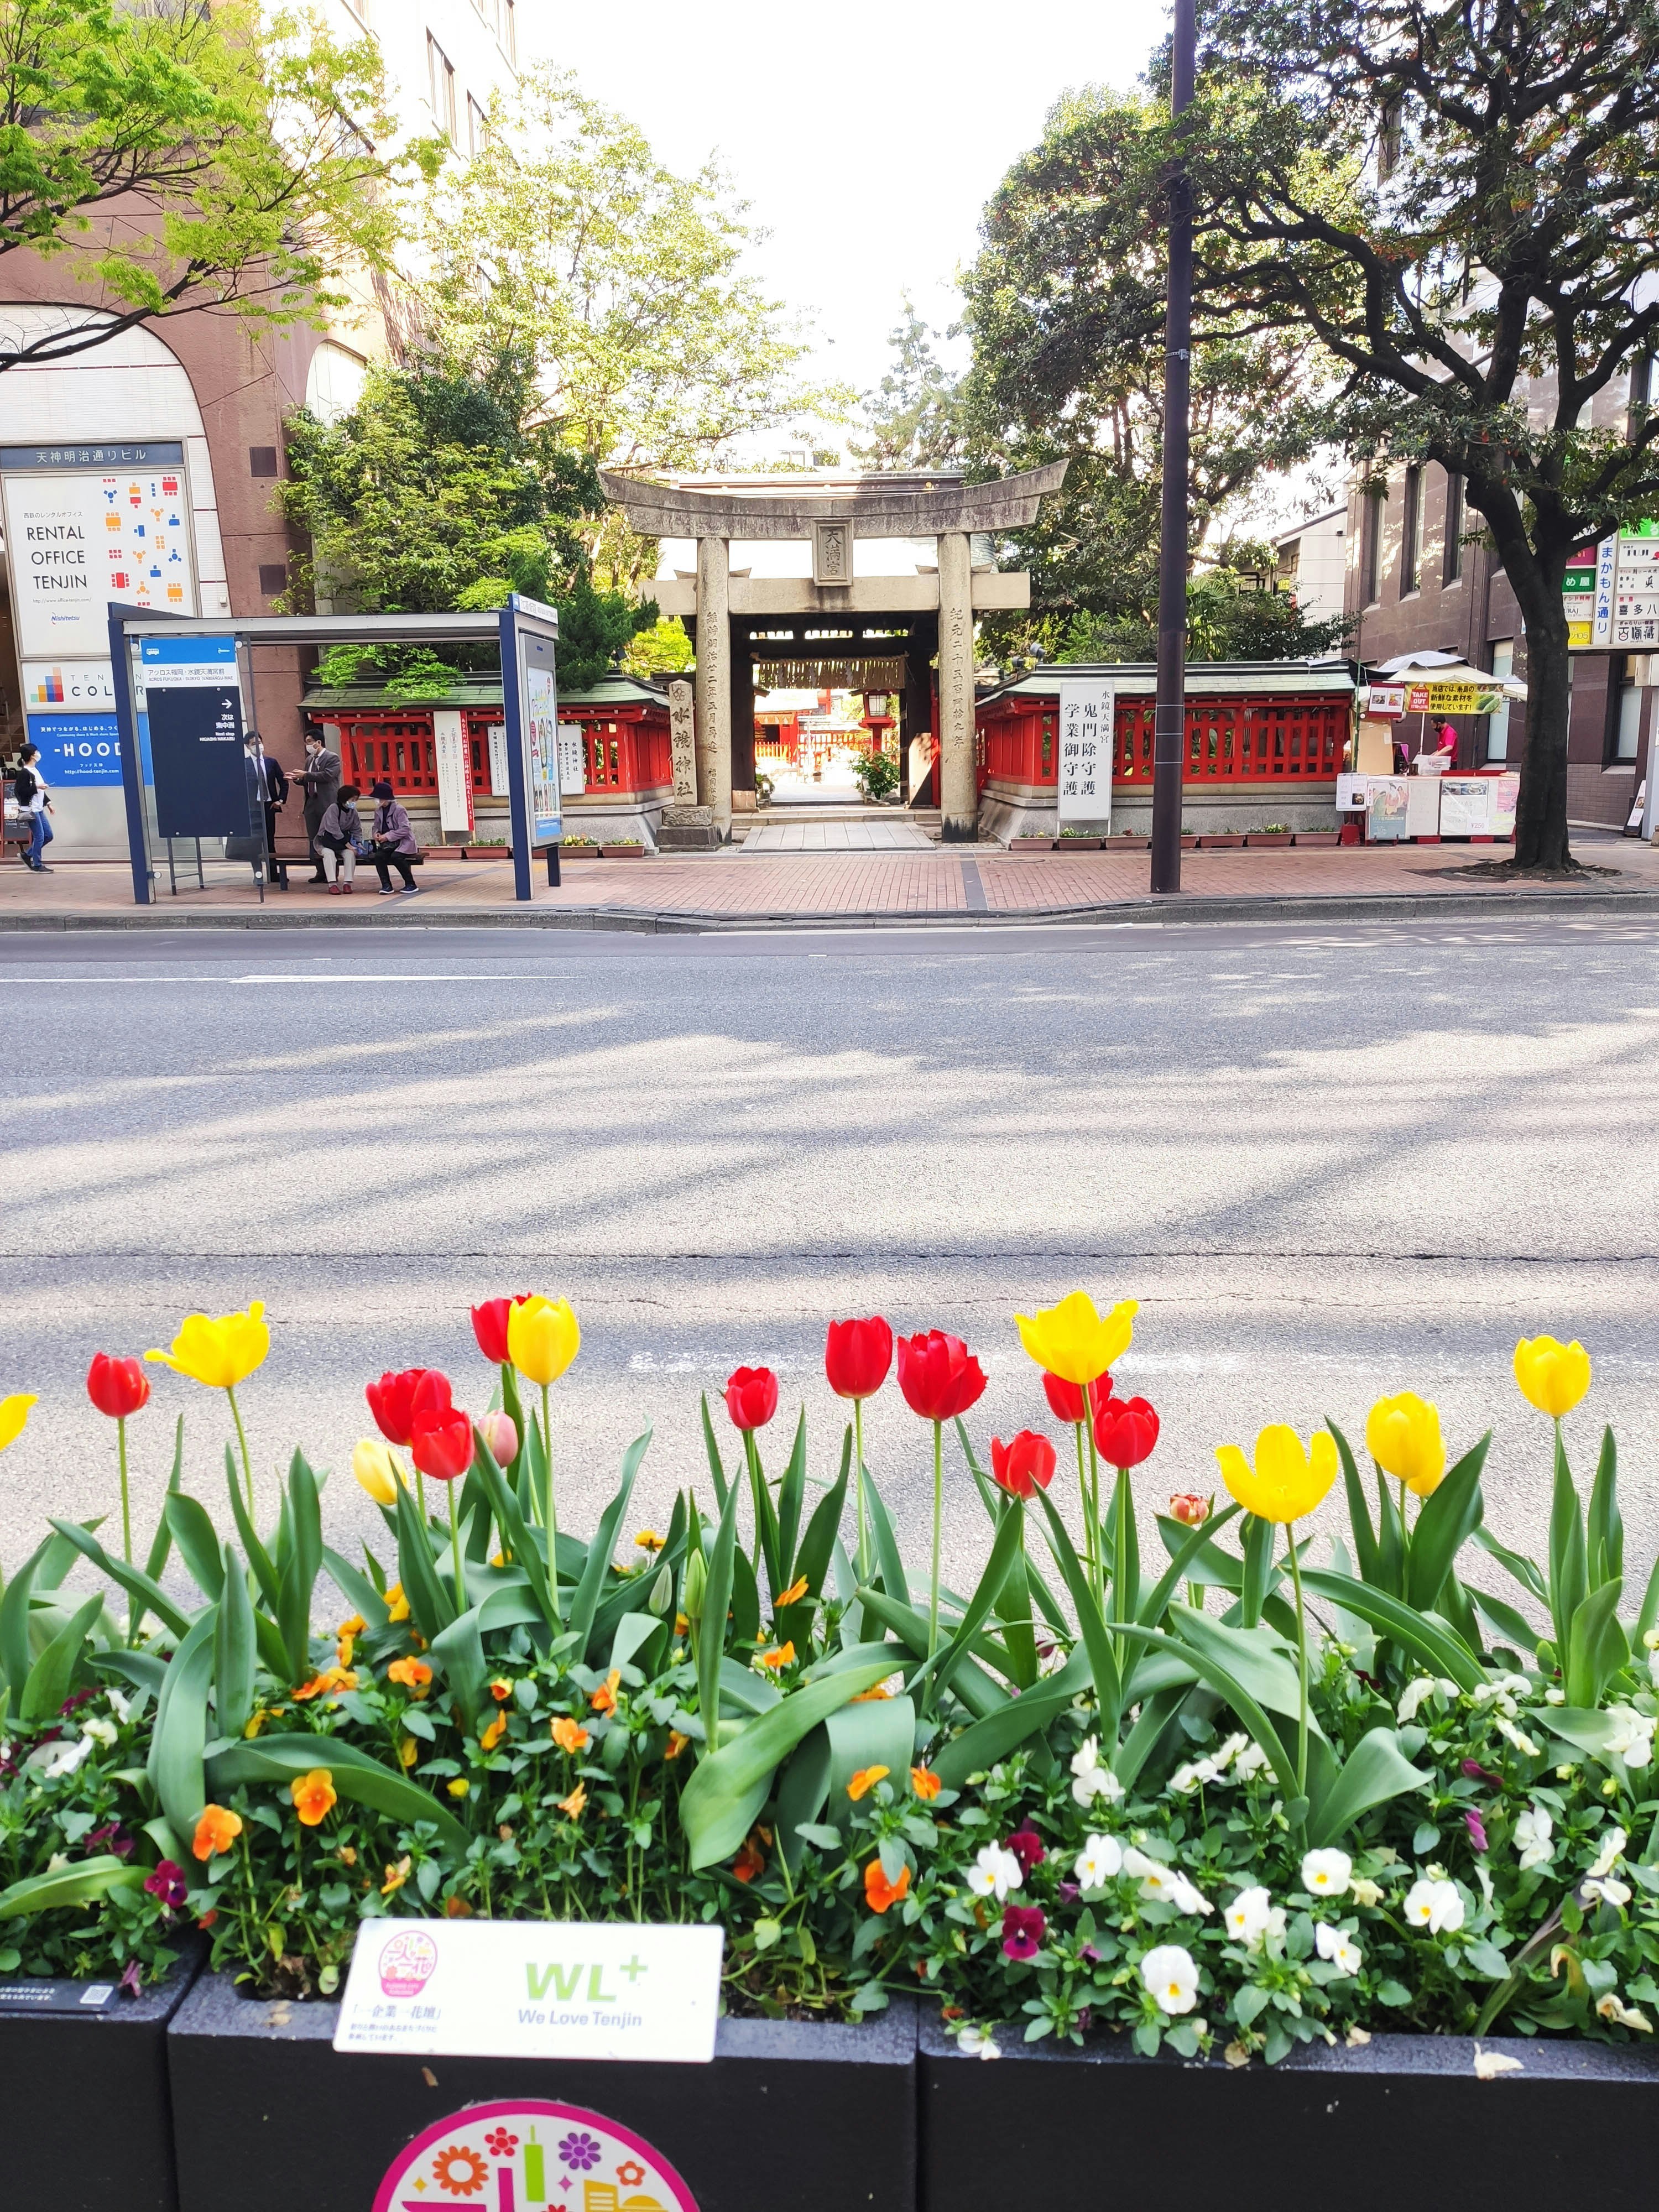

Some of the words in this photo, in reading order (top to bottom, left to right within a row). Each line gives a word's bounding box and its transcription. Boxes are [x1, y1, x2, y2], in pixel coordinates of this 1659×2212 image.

[36, 449, 147, 463] 天神明治通りビル
[27, 526, 85, 540] RENTAL
[31, 550, 85, 565] OFFICE
[33, 575, 87, 589] TENJIN
[1619, 604, 1657, 615] 喜多八
[1100, 691, 1110, 743] 水鏡天満宮
[671, 707, 692, 796] 水鏡神社
[1063, 703, 1080, 795] 学業御守護
[1081, 703, 1098, 795] 鬼門除守護
[519, 2009, 545, 2024] We
[550, 2010, 589, 2025] Love
[593, 2011, 642, 2029] Tenjin
